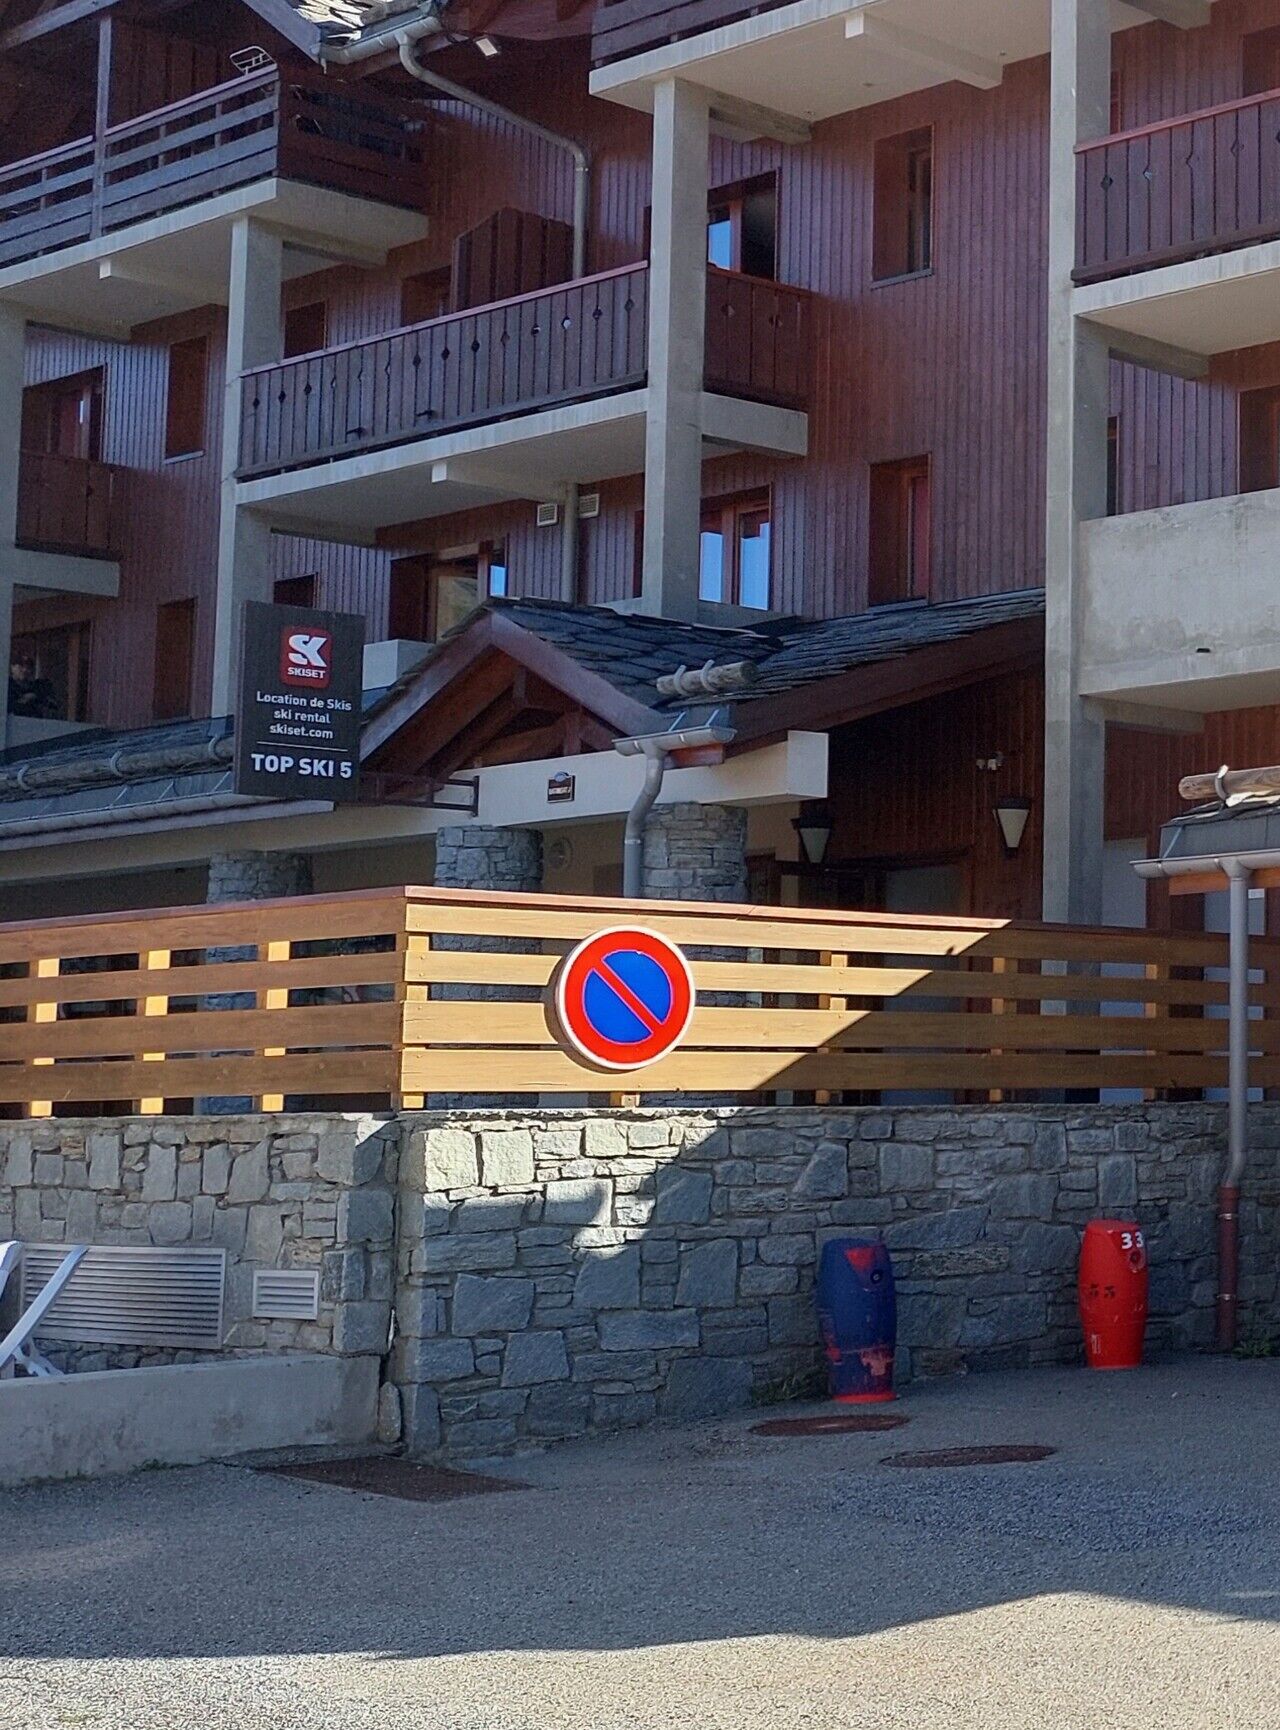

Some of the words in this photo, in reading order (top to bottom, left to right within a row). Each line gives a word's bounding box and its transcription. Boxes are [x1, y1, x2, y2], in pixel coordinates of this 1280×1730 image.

[288, 667, 325, 679] SKISET
[256, 690, 307, 707] Location
[309, 695, 325, 708] de
[327, 698, 352, 711] Skis
[274, 709, 293, 720] ski
[294, 711, 331, 724] rental
[269, 724, 334, 739] skiset.com
[251, 753, 294, 773] TOP
[298, 757, 335, 777] SKI
[340, 761, 353, 778] 5
